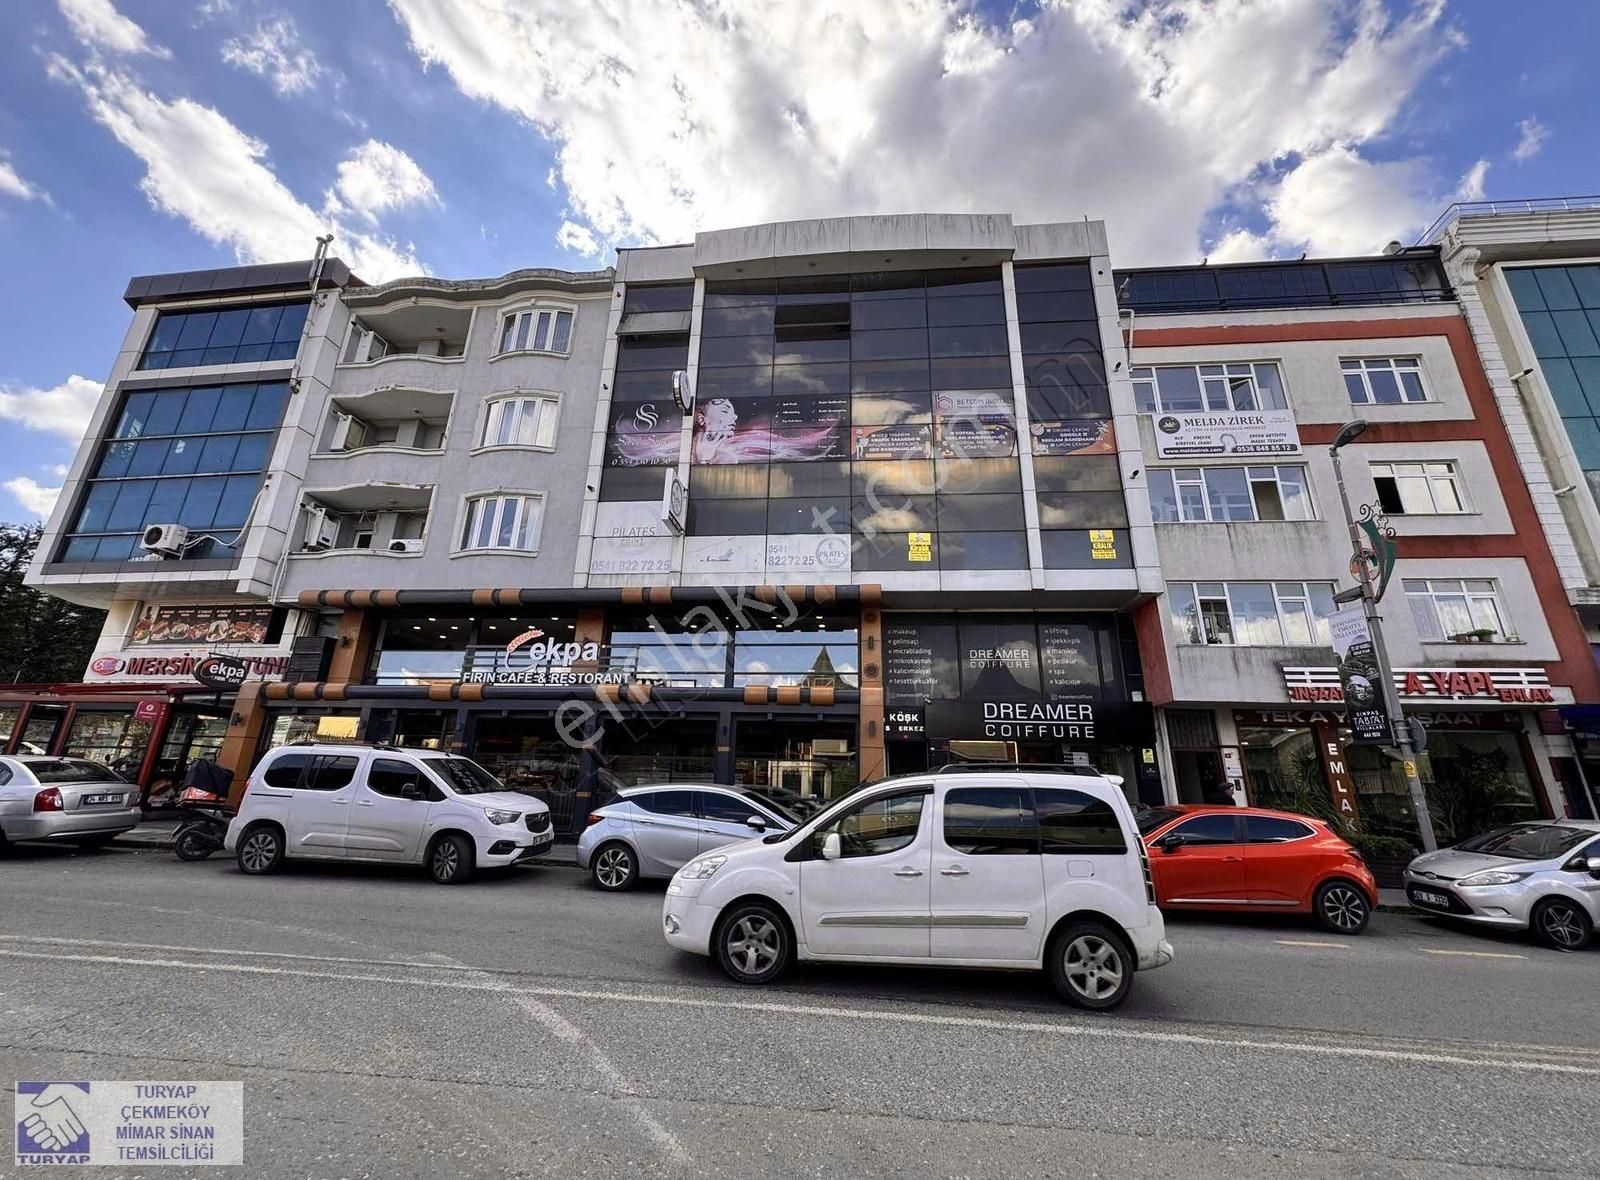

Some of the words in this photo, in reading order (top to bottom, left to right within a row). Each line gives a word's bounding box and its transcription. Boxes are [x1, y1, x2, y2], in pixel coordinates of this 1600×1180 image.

[1184, 417, 1224, 427] MELDA
[1227, 414, 1265, 425] ZİREK
[592, 559, 616, 571] 0541
[640, 559, 655, 571] 72
[656, 559, 671, 571] 25
[529, 637, 598, 667] ekpa
[969, 649, 1030, 659] DREAMER
[125, 654, 199, 675] MERSİN
[209, 662, 245, 679] ekpa
[970, 661, 1030, 669] COIFFURE
[462, 672, 496, 684] FIRIN
[537, 673, 547, 684] &
[550, 673, 630, 684] RESTORANT
[1430, 672, 1499, 694] YAPI
[1501, 687, 1555, 702] EMLAK
[889, 711, 919, 724] KÖŞK
[983, 702, 1094, 720] DREAMER
[985, 724, 1095, 738] COIFFURE
